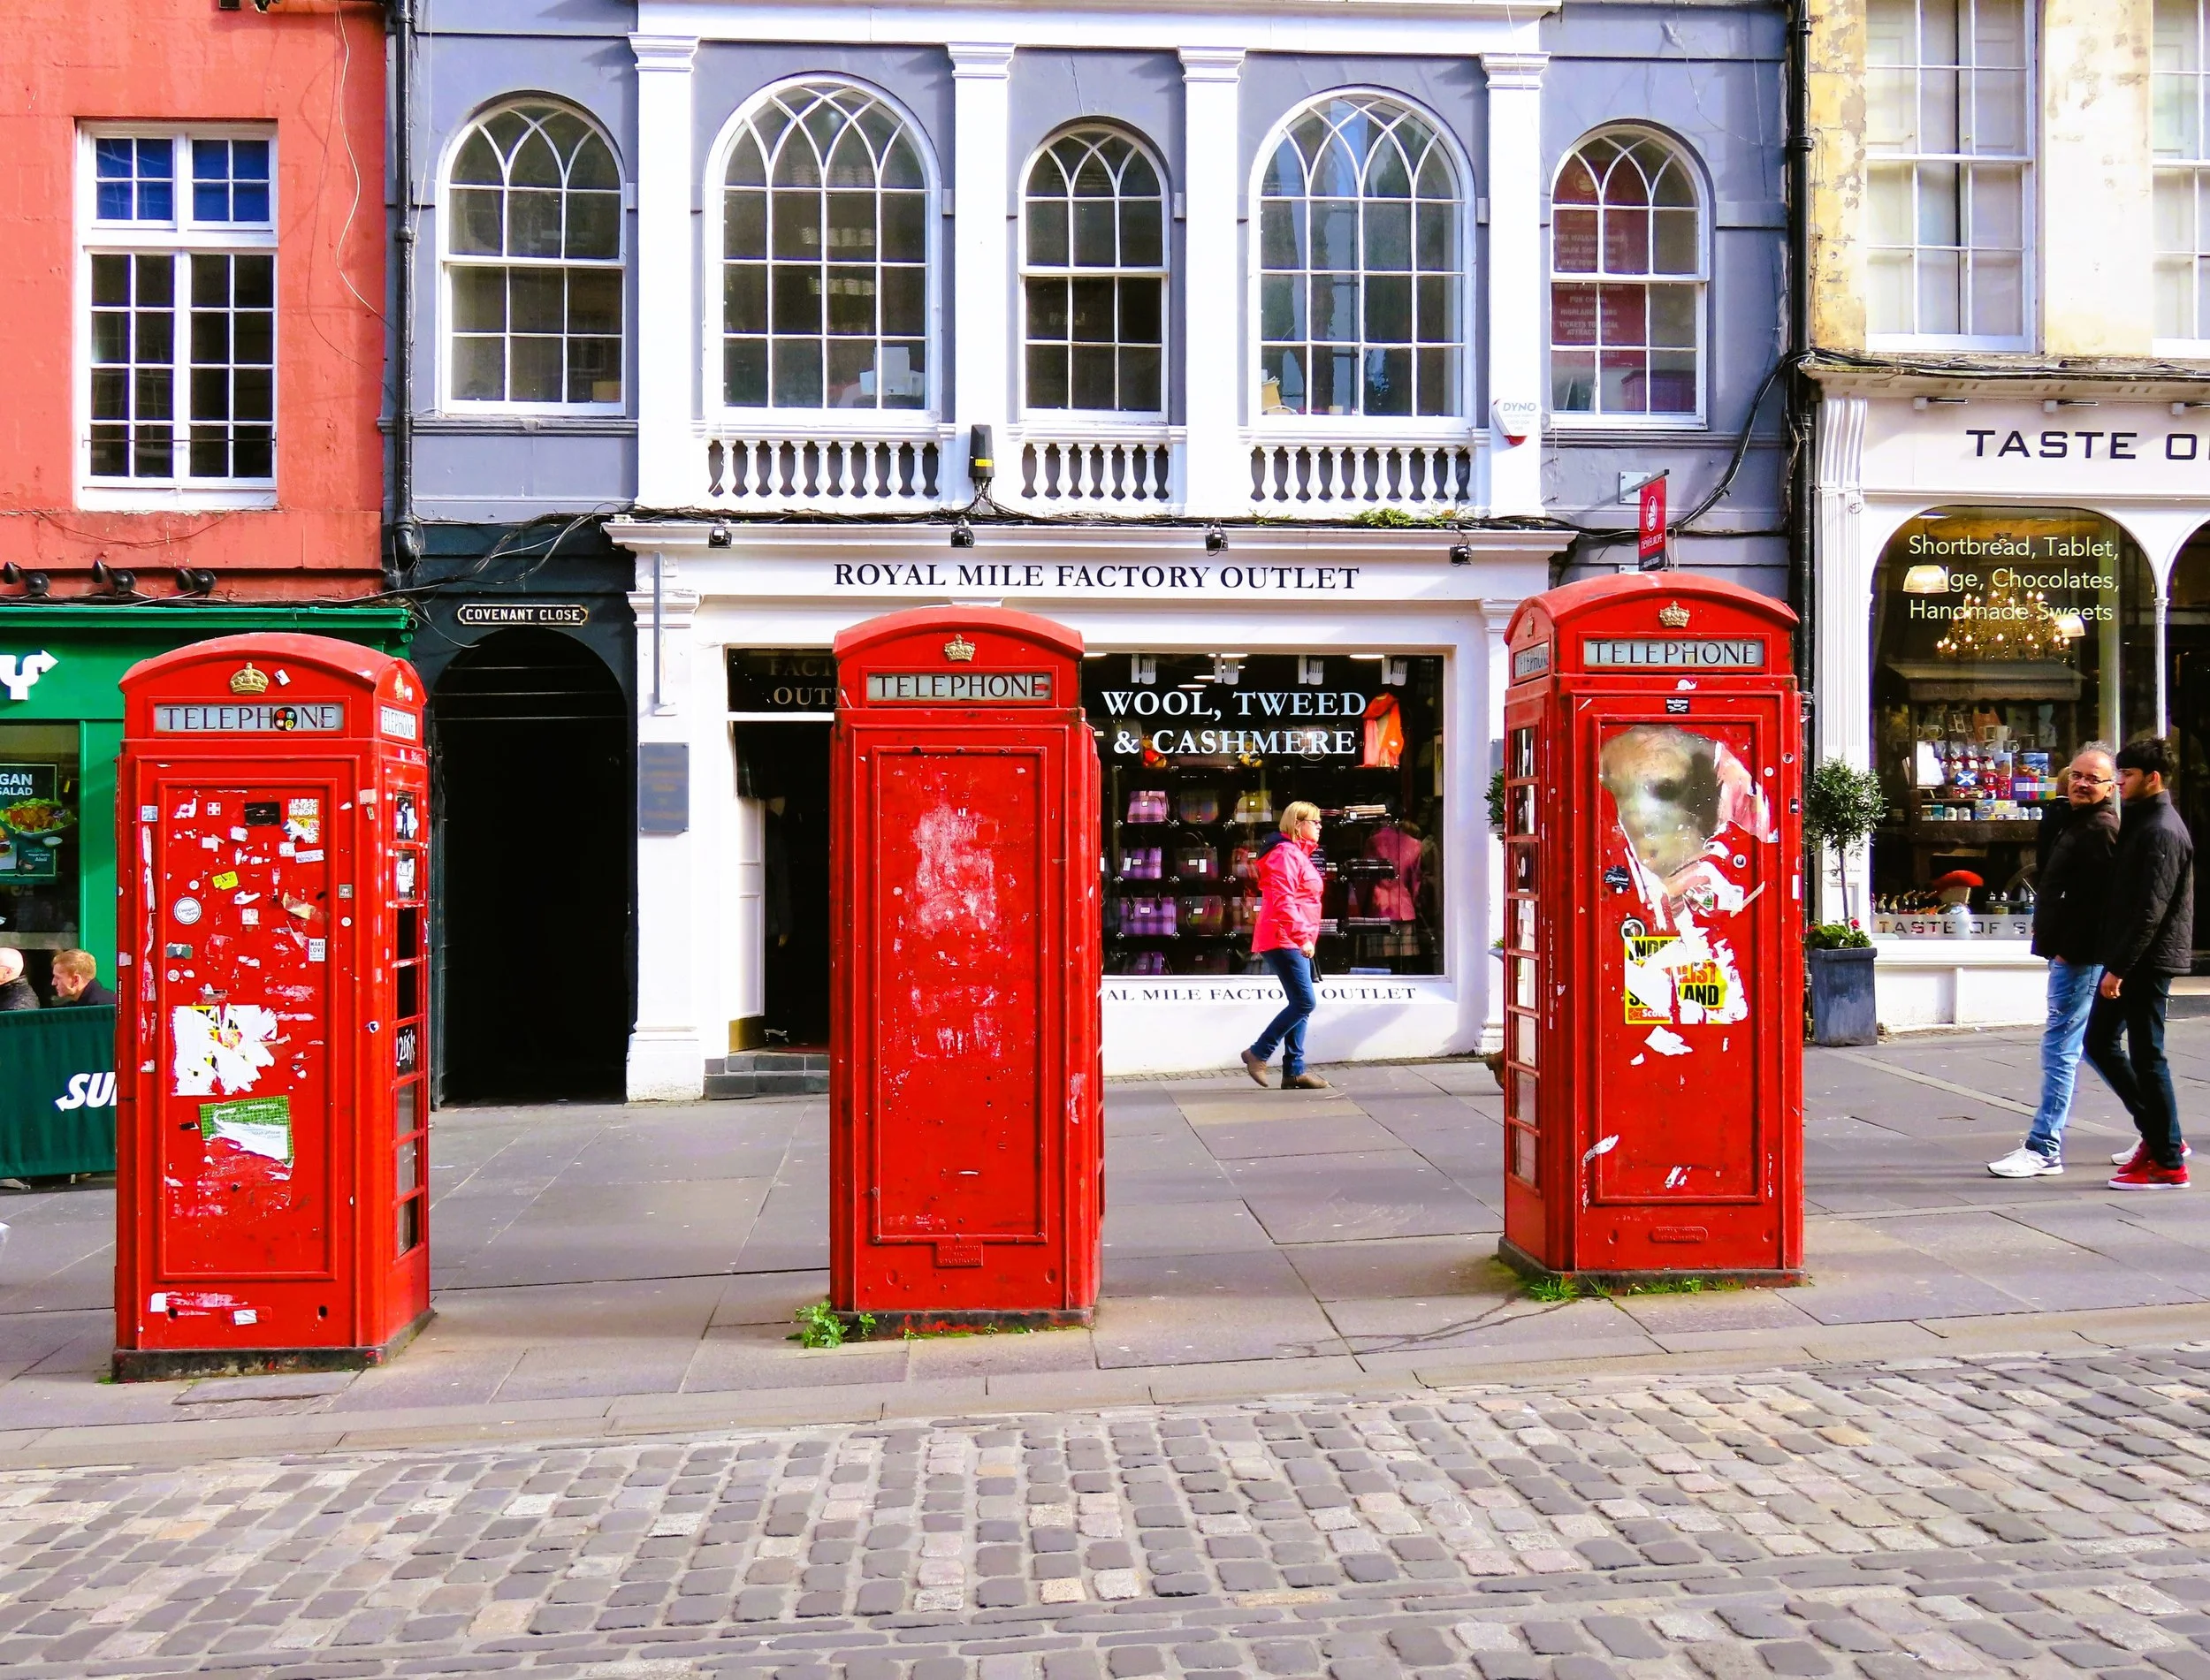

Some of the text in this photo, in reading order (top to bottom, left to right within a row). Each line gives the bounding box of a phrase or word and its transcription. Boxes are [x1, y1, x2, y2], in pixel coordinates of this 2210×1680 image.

[1504, 402, 1536, 412] DYNO
[1966, 430, 2210, 460] TASTE O
[1908, 535, 2120, 560] Shortbread, Tablet,
[834, 563, 1360, 589] ROYAL MILE FACTORY OUTLET
[1992, 567, 2120, 592] Chocolates,
[466, 608, 581, 620] COVENANT CLOSE
[1909, 599, 2113, 621] Handmade Sweets
[1590, 642, 1757, 665] TELEPHONE
[875, 675, 1045, 697] TELEPHONE
[1101, 691, 1367, 721] WOOL, TWEED
[163, 706, 336, 730] TELEPHNE
[1113, 730, 1356, 755] & CASHMERE
[1877, 921, 1956, 934] TASTE
[2012, 922, 2033, 935] S
[1099, 989, 1135, 1000] AL
[1142, 988, 1201, 1000] MILE
[1322, 987, 1417, 1000] OUTLET
